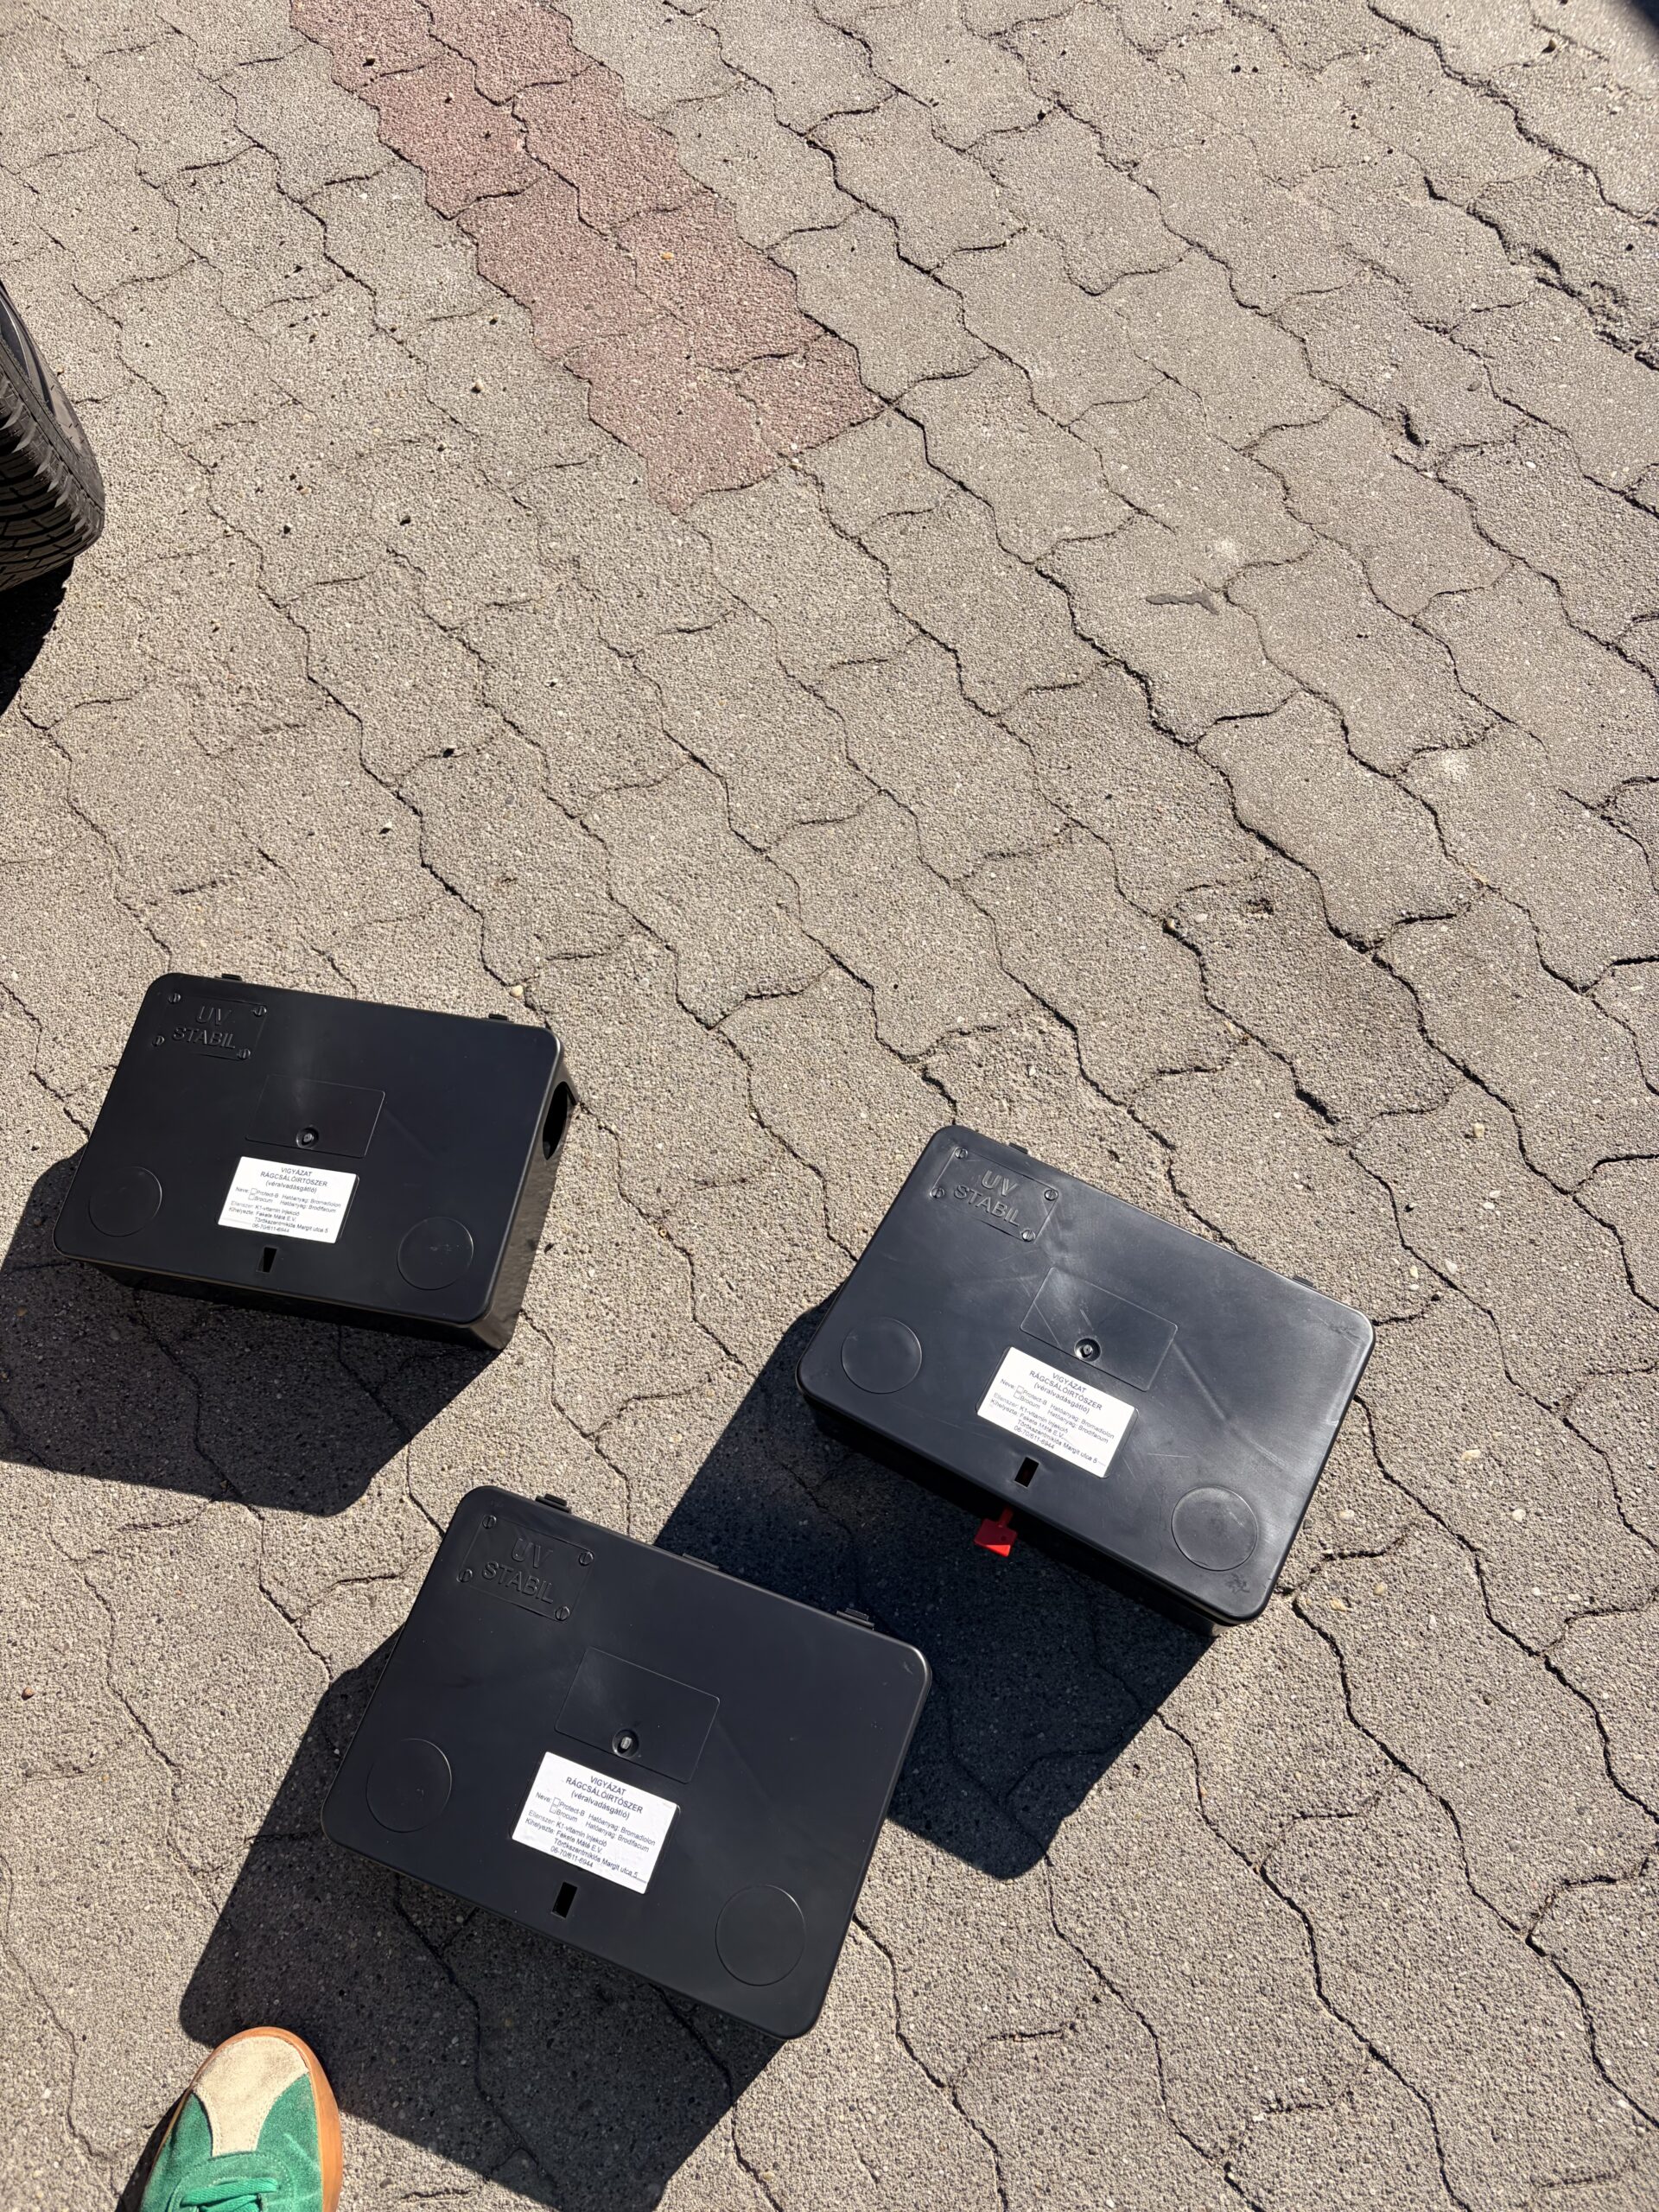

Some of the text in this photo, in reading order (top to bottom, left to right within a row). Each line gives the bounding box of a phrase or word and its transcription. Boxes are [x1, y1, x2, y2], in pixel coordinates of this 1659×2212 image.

[195, 1006, 232, 1026] UV
[172, 1027, 236, 1049] STABIL
[981, 1170, 1019, 1198] UV
[953, 1185, 1020, 1227] STABIL
[1052, 1373, 1087, 1393] VIGYÁZAT
[512, 1537, 554, 1569] UV
[482, 1560, 554, 1605] STABIL
[565, 1777, 643, 1814] RÁGCSÁLÓIRTÓSZER
[590, 1776, 626, 1796] VIGYÁZAT
[556, 1808, 578, 1822] Brocum
[559, 1802, 585, 1816] Protect-B
[620, 1827, 656, 1846] Bromadiolon
[556, 1830, 575, 1843] Fekete
[601, 1858, 620, 1871] Margit
[620, 1867, 632, 1876] utca
